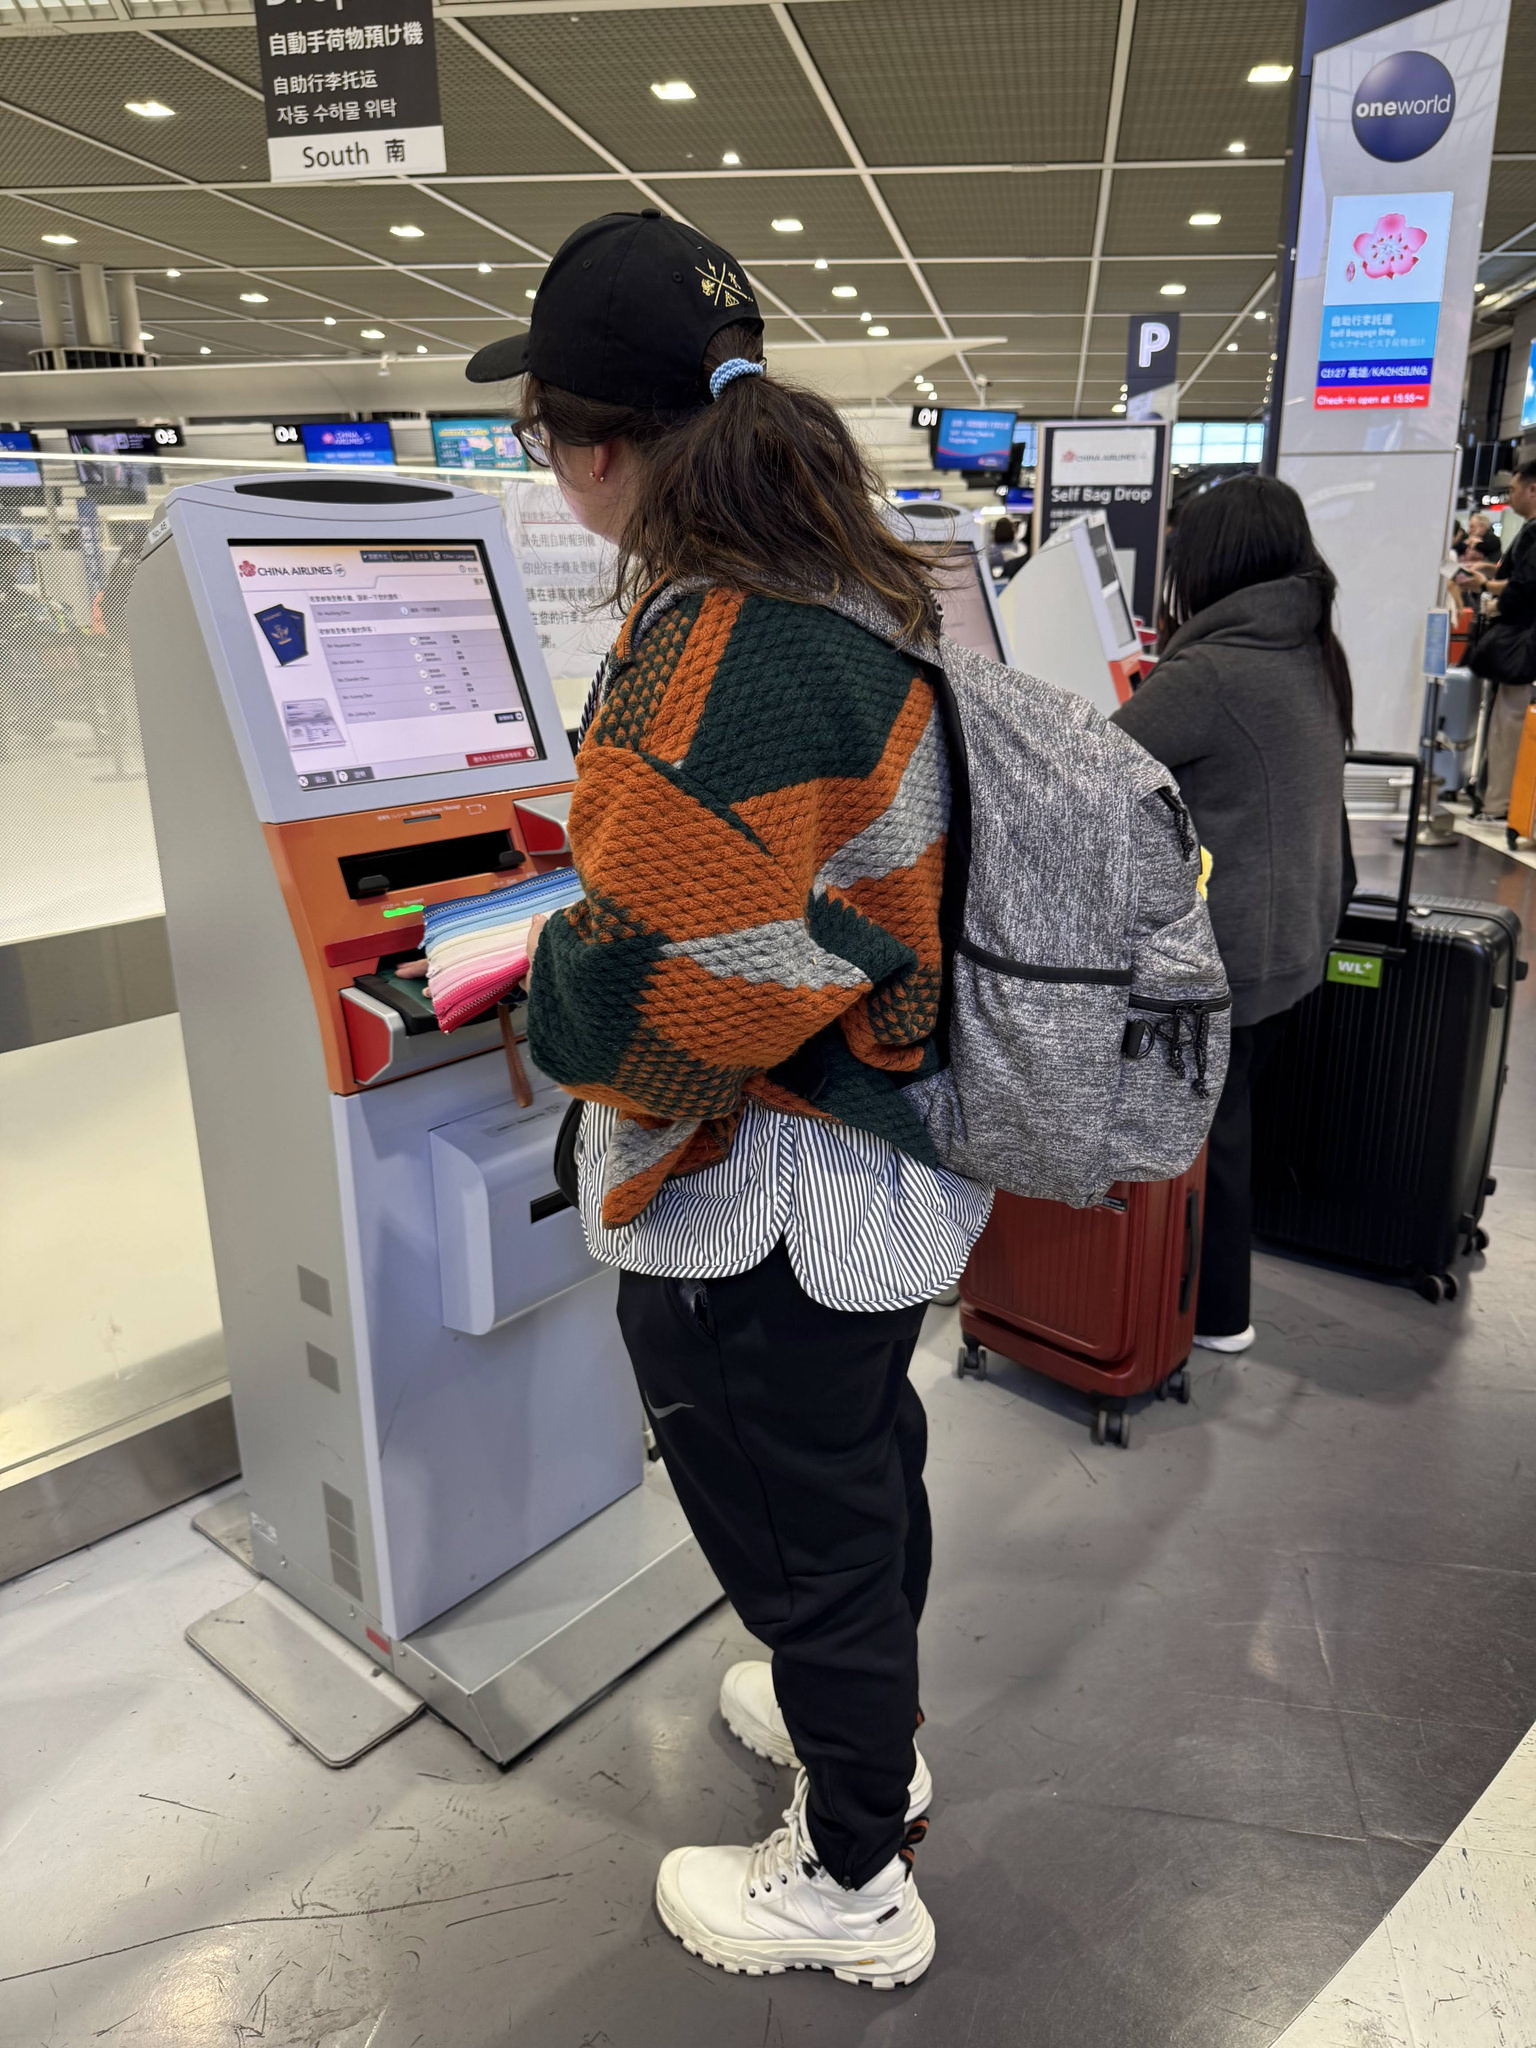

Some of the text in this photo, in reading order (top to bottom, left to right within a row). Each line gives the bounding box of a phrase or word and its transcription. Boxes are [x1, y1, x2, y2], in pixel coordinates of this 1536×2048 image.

[268, 21, 424, 56] 自動手荷物預け機
[273, 70, 378, 96] 自助行李托运
[277, 98, 397, 125] 자동 수하물 위탁
[1355, 93, 1451, 118] oneworld
[303, 139, 406, 169] South 南
[1138, 322, 1170, 368] P
[918, 408, 938, 427] 01
[155, 429, 177, 444] 05
[275, 426, 298, 442] 04
[1051, 487, 1152, 505] Self Bag Drop
[257, 565, 332, 577] CHINA AIRLINES
